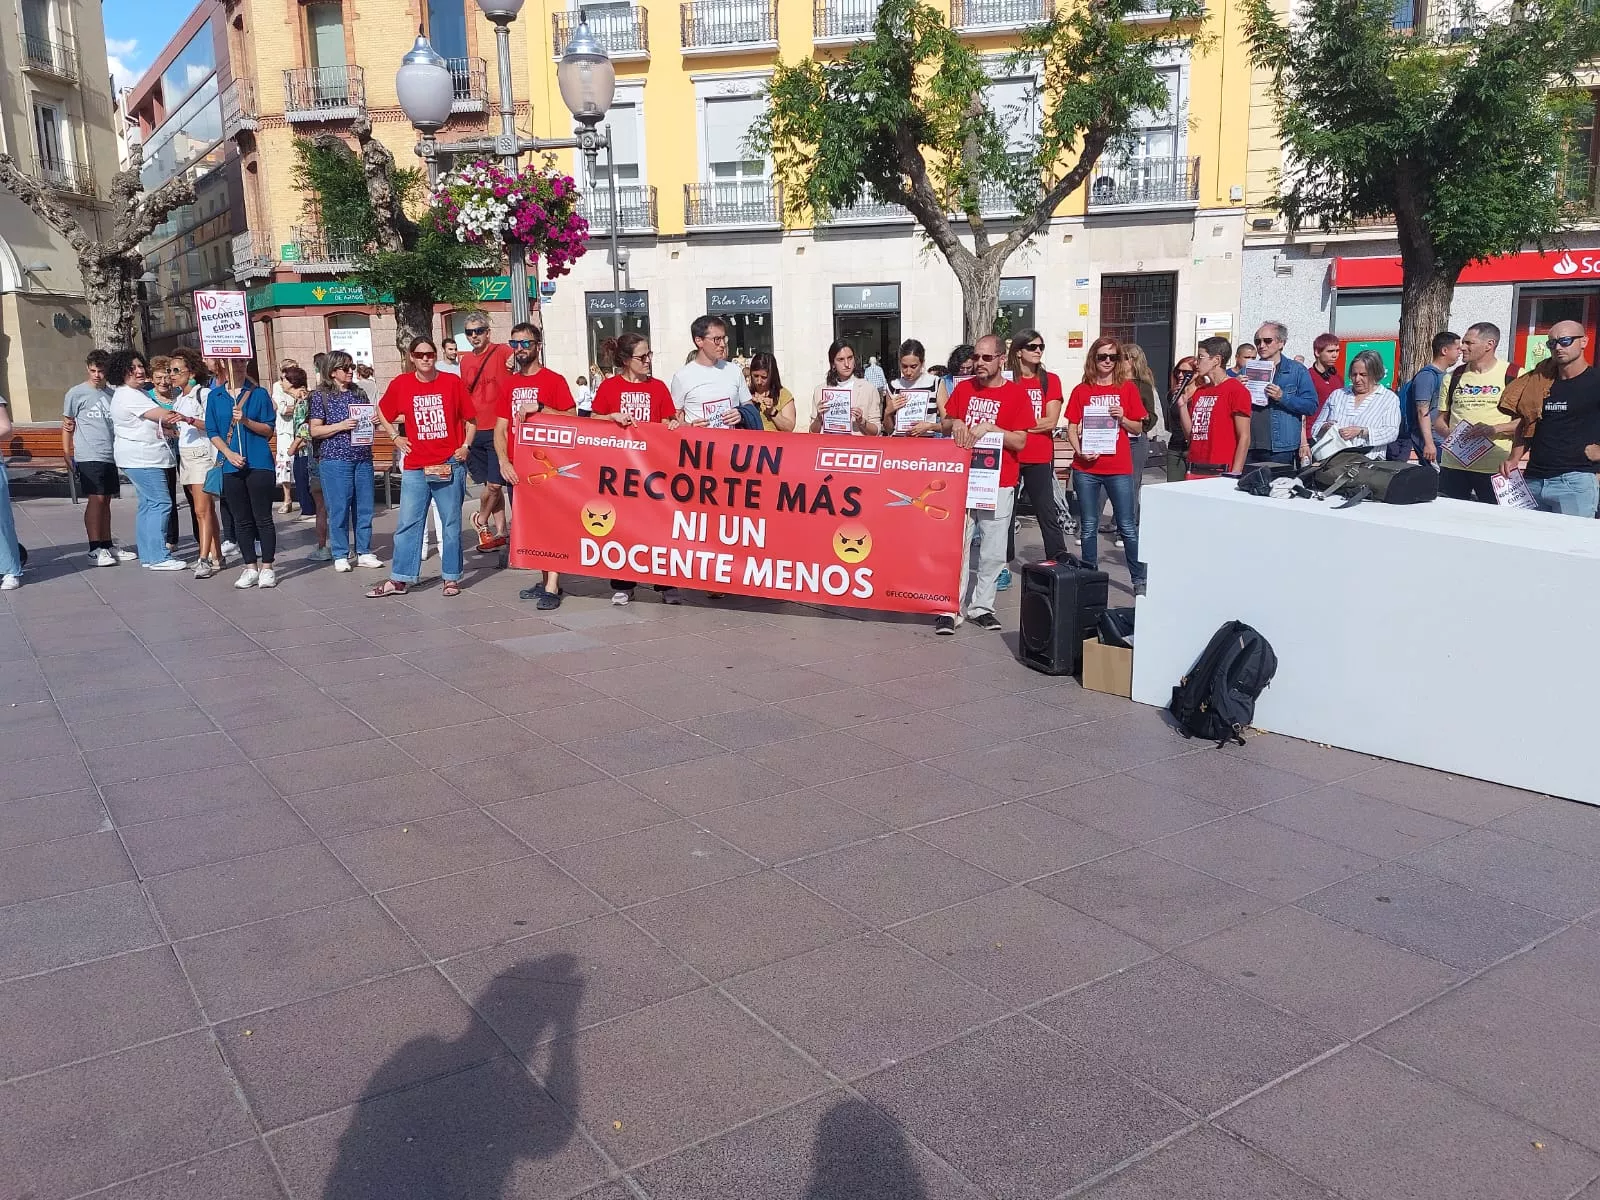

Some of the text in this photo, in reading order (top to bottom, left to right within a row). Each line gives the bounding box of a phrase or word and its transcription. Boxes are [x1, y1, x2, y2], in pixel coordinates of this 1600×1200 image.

[200, 296, 216, 311] NO
[711, 294, 768, 306] Pilar Prieto
[201, 310, 245, 322] RECORTES
[213, 322, 241, 332] CUPOS
[512, 388, 538, 400] SOMOS
[621, 393, 651, 404] SOMOS
[413, 396, 443, 407] SOMOS
[968, 399, 1000, 414] SOMOS
[1090, 396, 1120, 406] SOMOS
[621, 407, 650, 421] PEOR
[706, 404, 716, 414] NO
[414, 409, 446, 425] PEOR
[417, 422, 447, 433] TRATADO
[417, 430, 449, 440] DE ESPAÑA
[522, 427, 647, 450] CCOO enseñanza
[678, 438, 783, 475] NI UN
[821, 452, 964, 473] CCOO enseñanza
[598, 466, 862, 516] RECORTE MÁS
[672, 510, 766, 548] NI UN
[580, 537, 874, 599] DOCENTE MENOS
